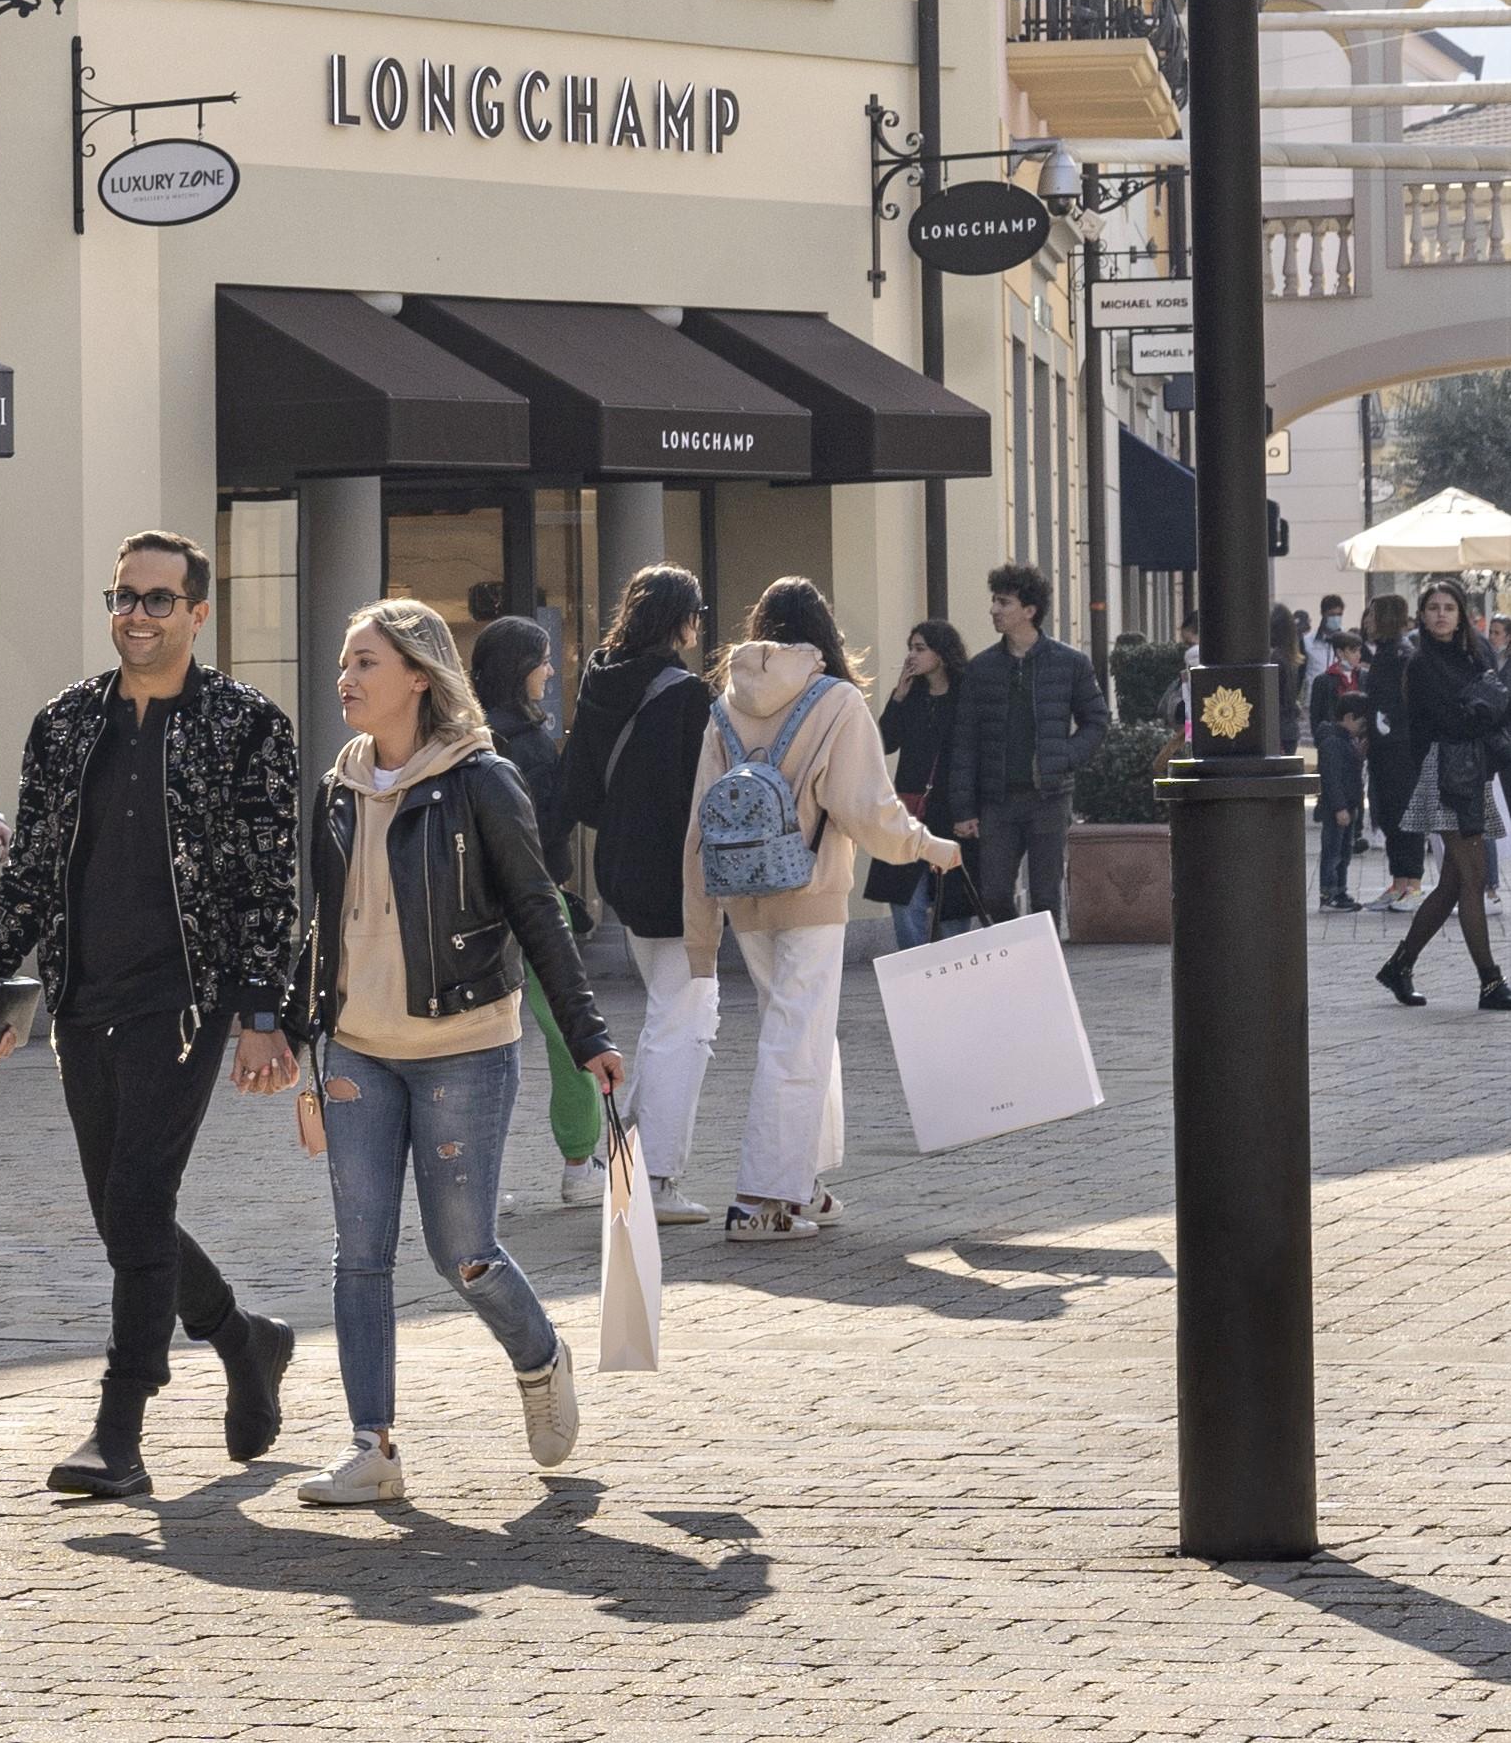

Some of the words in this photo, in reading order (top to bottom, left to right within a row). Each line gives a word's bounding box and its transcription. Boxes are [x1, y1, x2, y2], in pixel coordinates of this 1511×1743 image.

[329, 53, 740, 154] LONGCHAMP
[110, 172, 175, 194] LUXURY
[179, 168, 225, 189] ZONE
[920, 217, 1038, 242] LONGCHAMP
[1100, 299, 1152, 310] MICHAEL
[1156, 297, 1189, 308] KORS
[1139, 349, 1185, 359] MICHAEL
[662, 430, 755, 452] LONGCHAMP
[925, 946, 1010, 979] sandro
